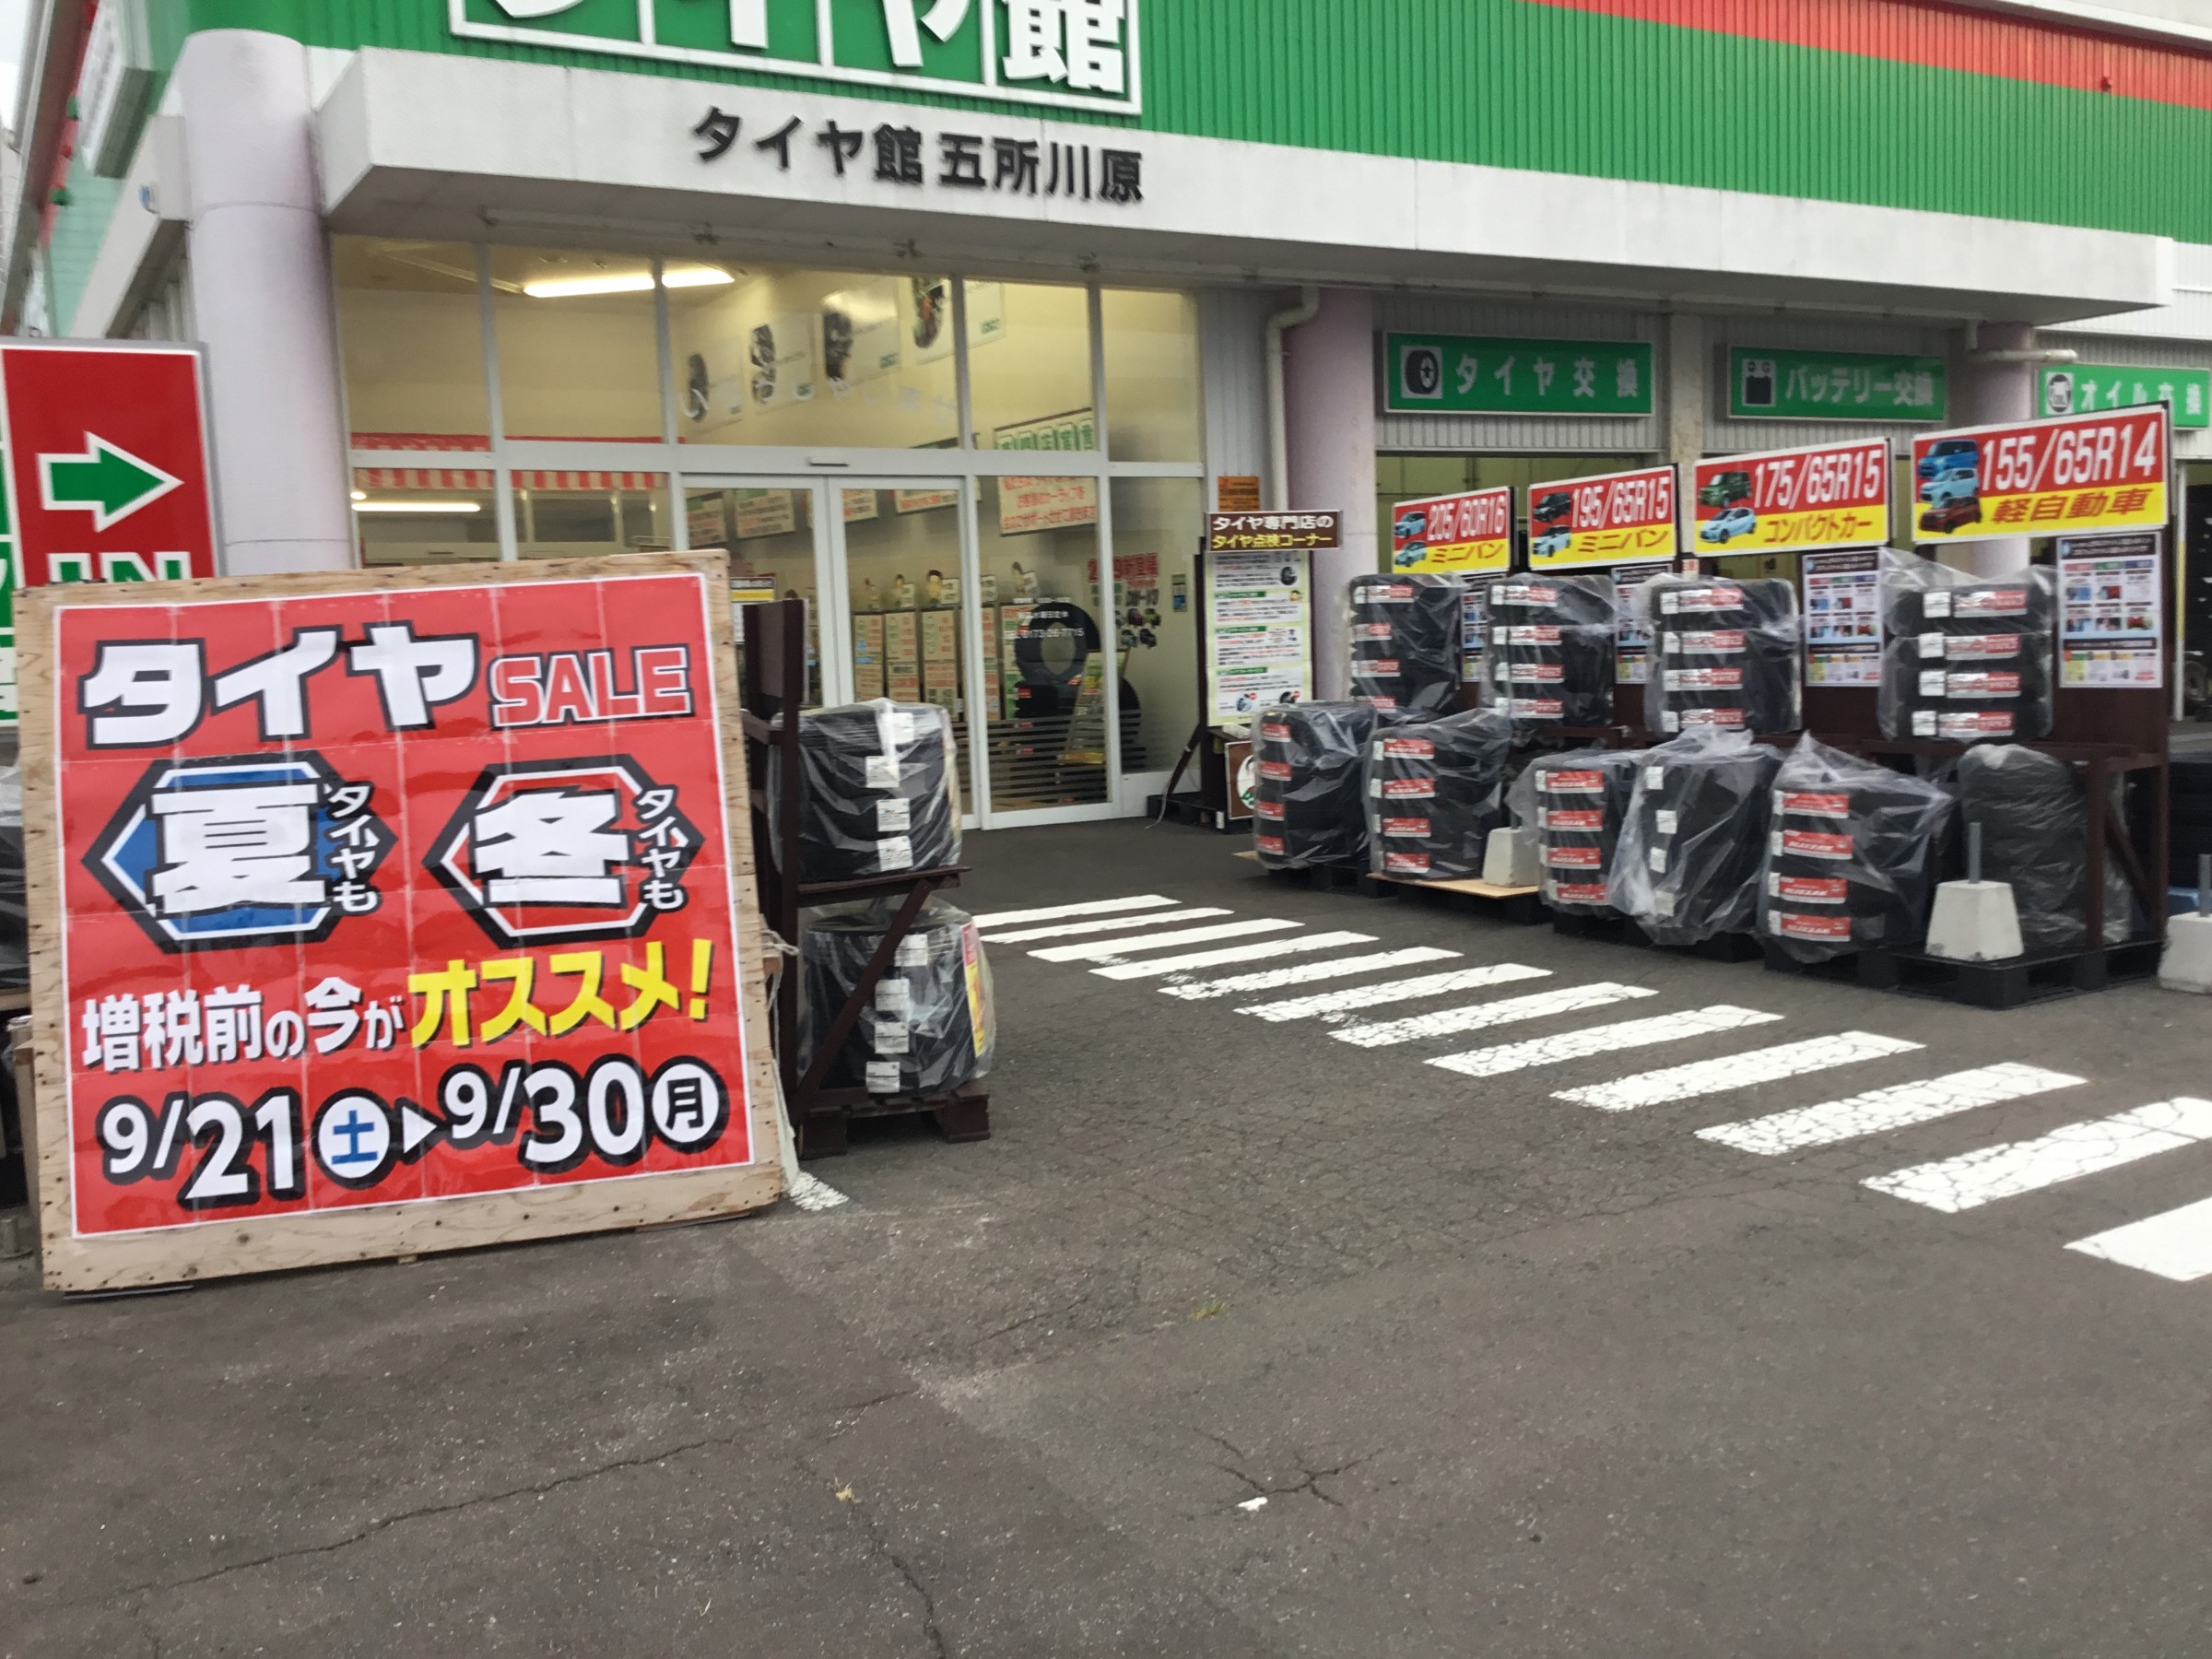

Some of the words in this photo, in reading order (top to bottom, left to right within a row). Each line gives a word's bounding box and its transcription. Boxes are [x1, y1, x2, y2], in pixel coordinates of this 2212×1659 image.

[692, 106, 1143, 202] タイヤ館五所川原
[1455, 353, 1638, 398] タイヤ交換
[1785, 367, 1934, 406] バッテリー交換
[1754, 449, 1883, 509] 175/65R15
[1983, 421, 2159, 492] 155/65R14
[1212, 515, 1334, 531] タイヤ専門店の
[1428, 495, 1506, 542] 205/60R16
[1572, 476, 1671, 529] 195/65R15
[1992, 488, 2153, 524] 軽自動車
[1212, 533, 1333, 548] タイヤ点検コーナー
[1577, 528, 1669, 552] ミニバン
[1764, 512, 1872, 543] コンパクトカー
[1431, 542, 1504, 563] ミニバン
[79, 623, 478, 747] タイヤ
[489, 646, 692, 728] SALE
[148, 782, 327, 913] 夏
[327, 782, 378, 915] タイヤも
[477, 790, 630, 905] 冬
[637, 787, 687, 912] タイヤも
